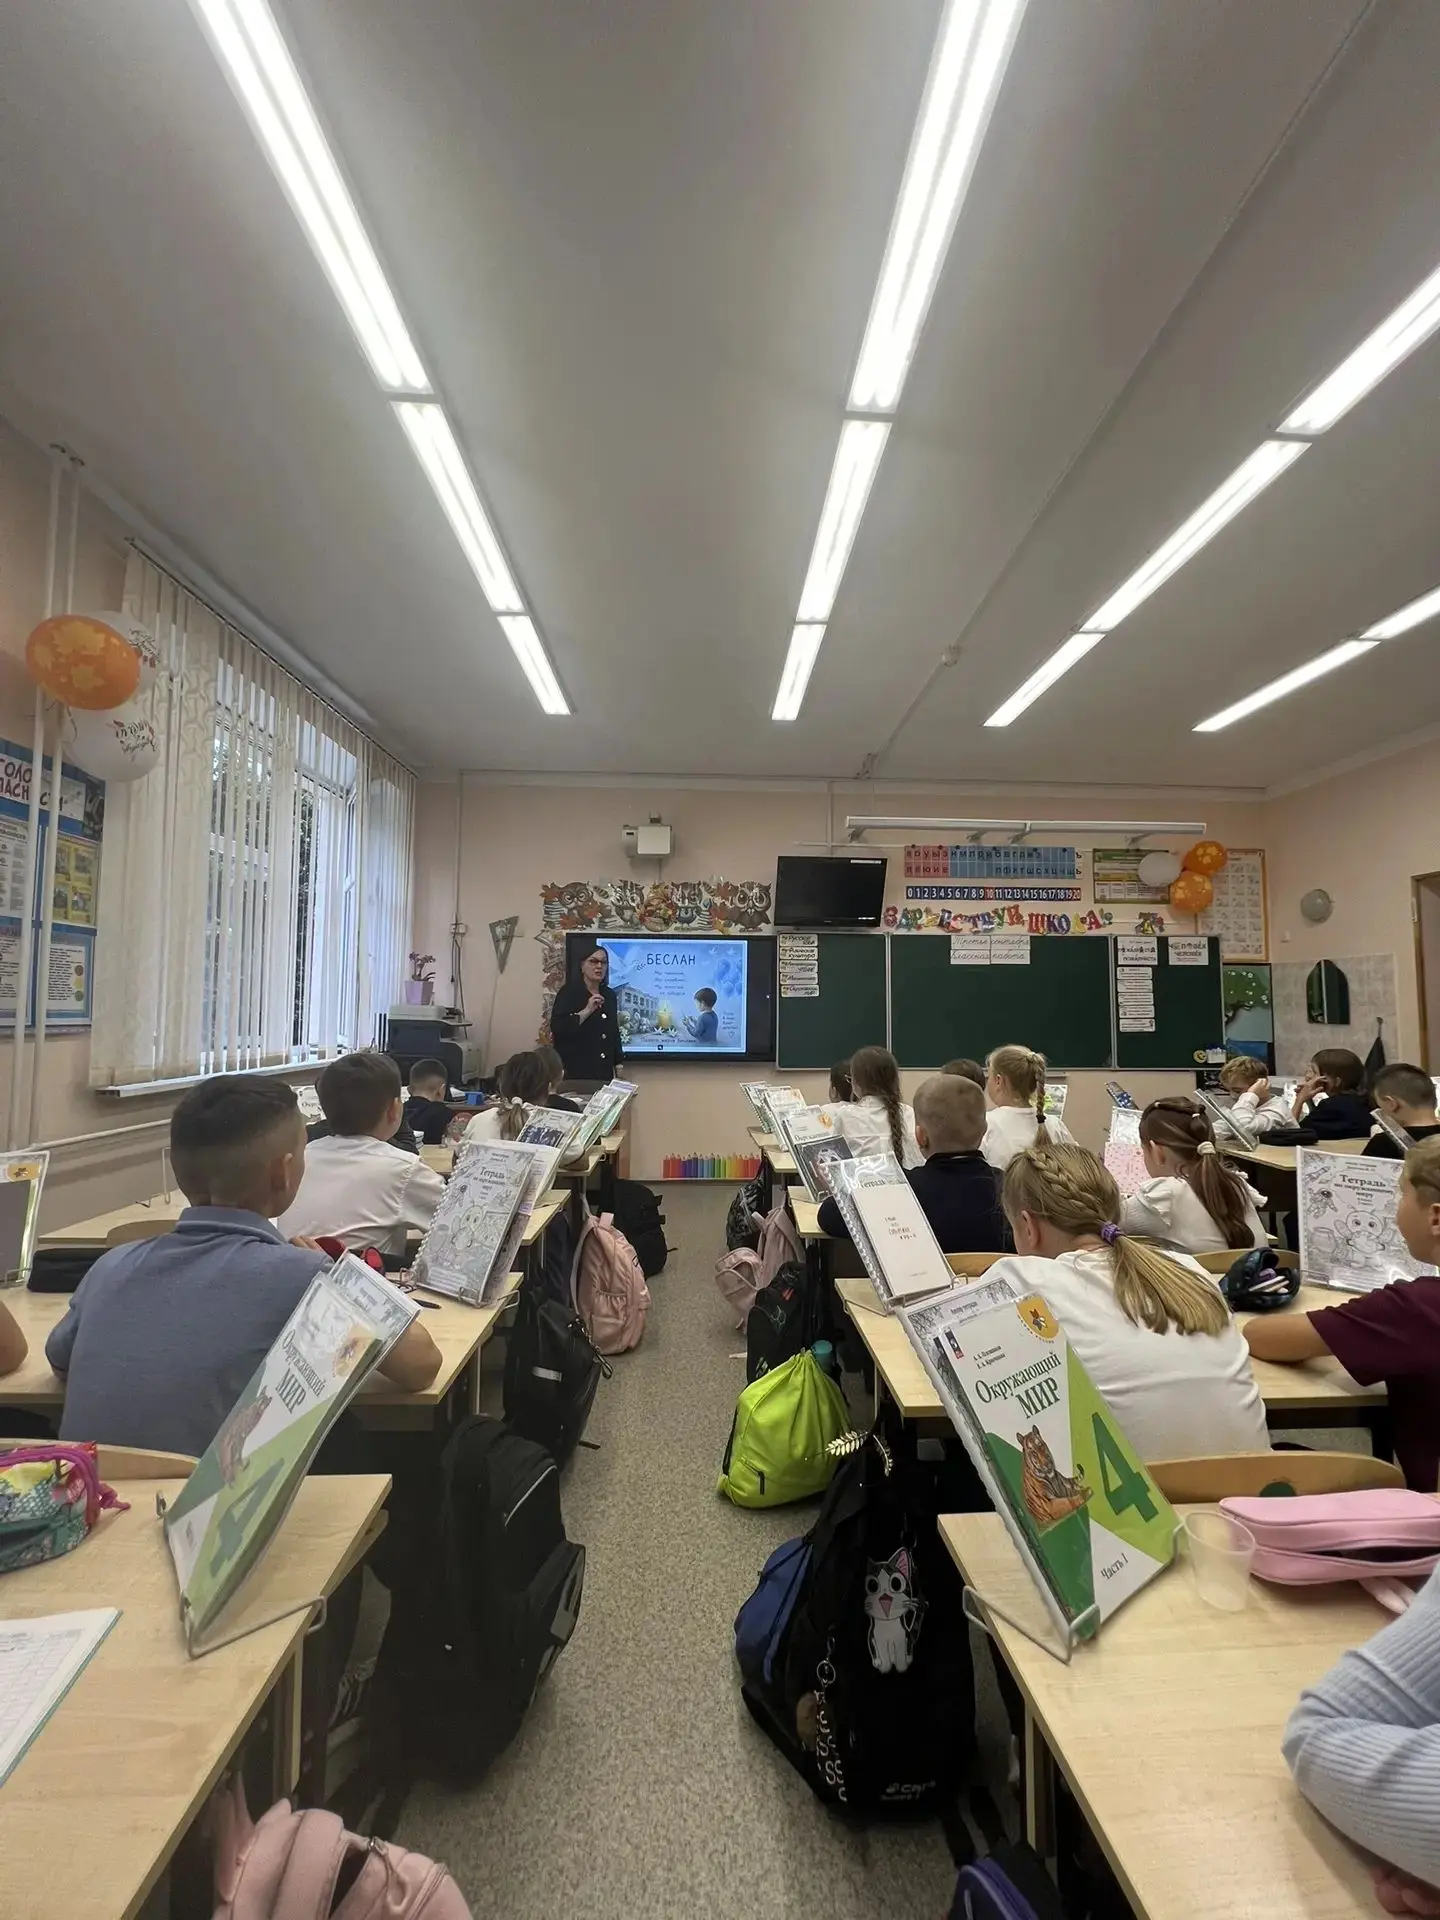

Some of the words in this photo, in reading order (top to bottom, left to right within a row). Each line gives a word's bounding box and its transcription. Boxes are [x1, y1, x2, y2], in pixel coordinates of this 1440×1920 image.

[908, 888, 913, 898] 0
[916, 888, 920, 898] 1
[924, 888, 929, 898] 2
[932, 888, 937, 898] 3
[940, 888, 945, 898] 4
[947, 888, 952, 898] 5
[955, 888, 961, 898] 6
[963, 888, 969, 898] 7
[971, 888, 977, 898] 8
[979, 888, 985, 898] 9
[986, 888, 993, 898] 10
[995, 888, 1002, 898] 11
[1005, 888, 1012, 898] 12
[1013, 888, 1021, 898] 13
[1022, 888, 1029, 898] 14
[1030, 888, 1037, 898] 15
[1040, 888, 1047, 898] 16
[1048, 888, 1056, 898] 17
[1057, 888, 1064, 898] 18
[1065, 888, 1072, 898] 19
[1073, 888, 1080, 898] 20
[646, 953, 696, 965] БЕСЛАН
[1339, 1174, 1387, 1188] Тетрадь
[275, 1367, 307, 1415] МИР
[975, 1350, 1062, 1404] Окружающий
[1015, 1376, 1061, 1420] МИР
[1092, 1411, 1160, 1524] 4
[208, 1457, 286, 1579] 4
[1100, 1559, 1124, 1580] Часть
